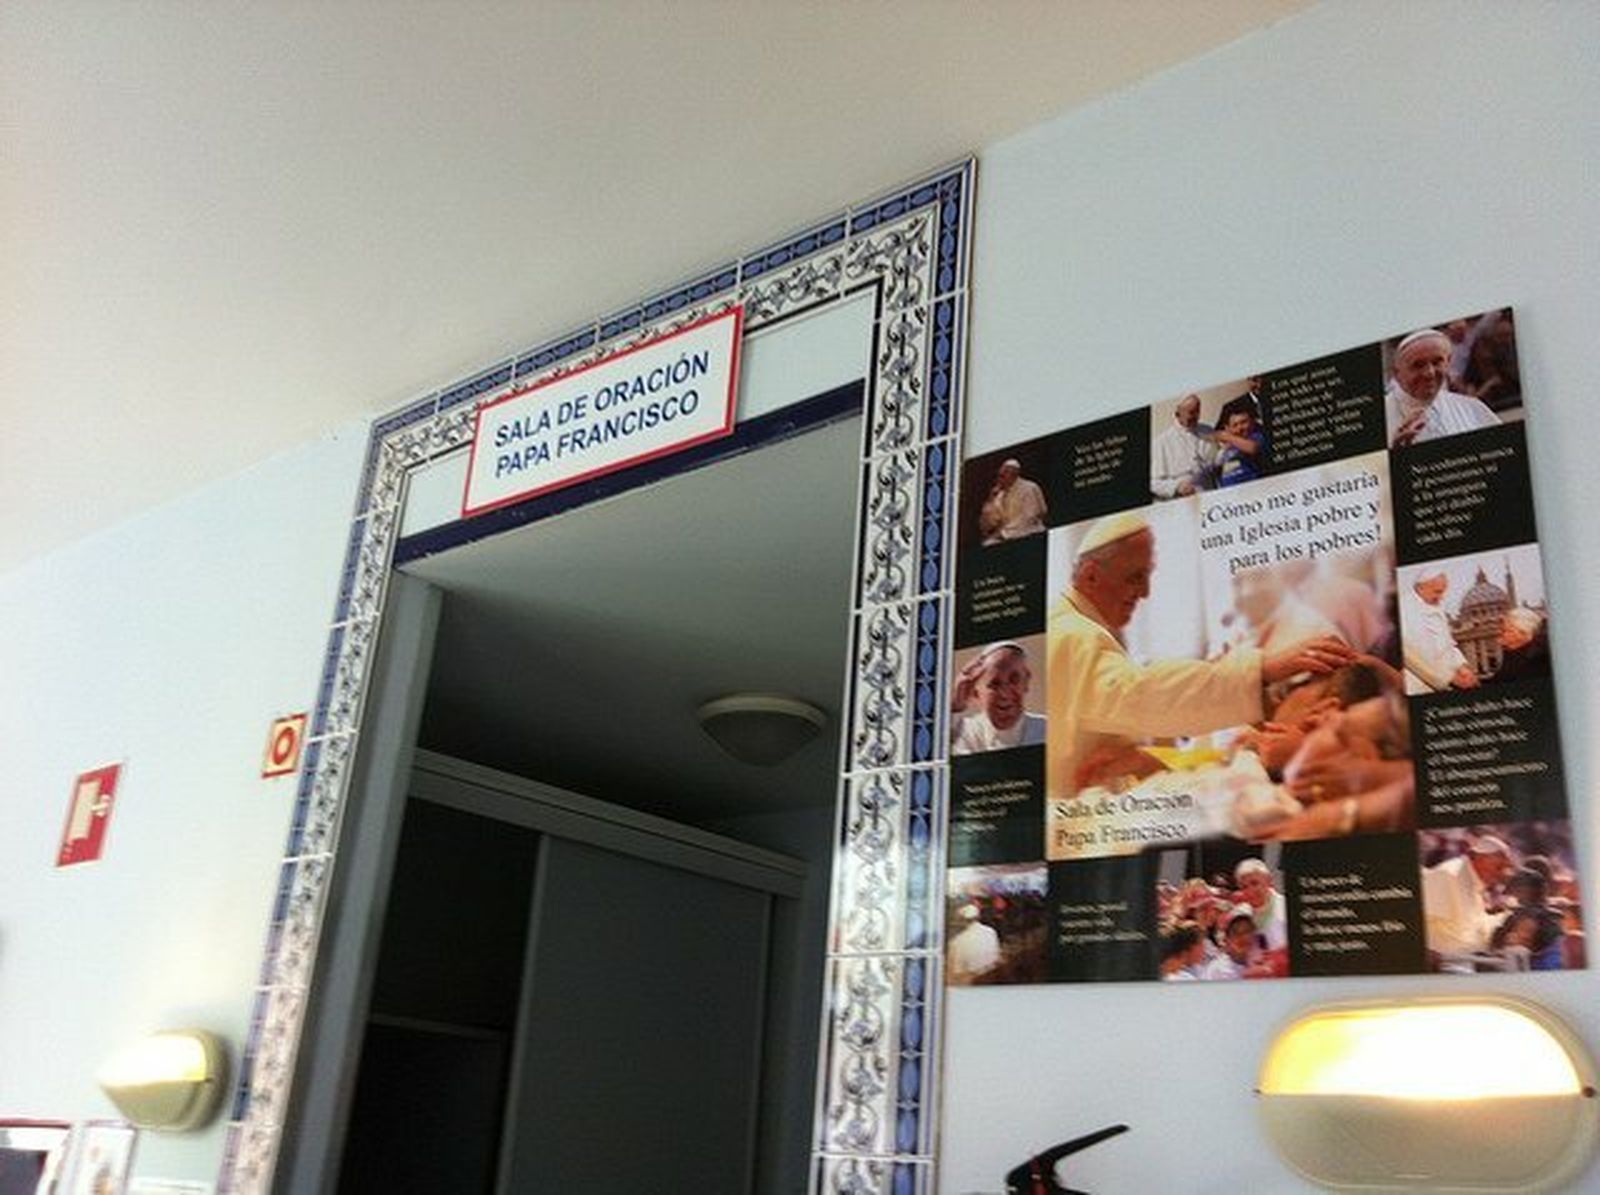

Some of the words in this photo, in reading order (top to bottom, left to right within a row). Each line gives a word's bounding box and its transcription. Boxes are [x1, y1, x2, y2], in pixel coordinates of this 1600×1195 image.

[495, 410, 550, 448] SALA
[557, 395, 588, 425] DE
[594, 351, 710, 411] ORACIÓN
[495, 441, 550, 478] PAPA
[556, 389, 699, 458] FRANCISCO
[1267, 494, 1296, 510] me
[1301, 471, 1379, 506] gustaría
[1201, 535, 1234, 550] una
[1239, 515, 1301, 544] Iglesia
[1306, 503, 1363, 531] pobre
[1367, 500, 1380, 518] y
[1229, 552, 1269, 575] para
[1275, 542, 1304, 561] los
[1308, 524, 1382, 560] pobres!
[1055, 799, 1091, 820] Sala
[1095, 797, 1117, 816] de
[1055, 828, 1095, 850] Papa
[1100, 823, 1188, 844] Francisco
